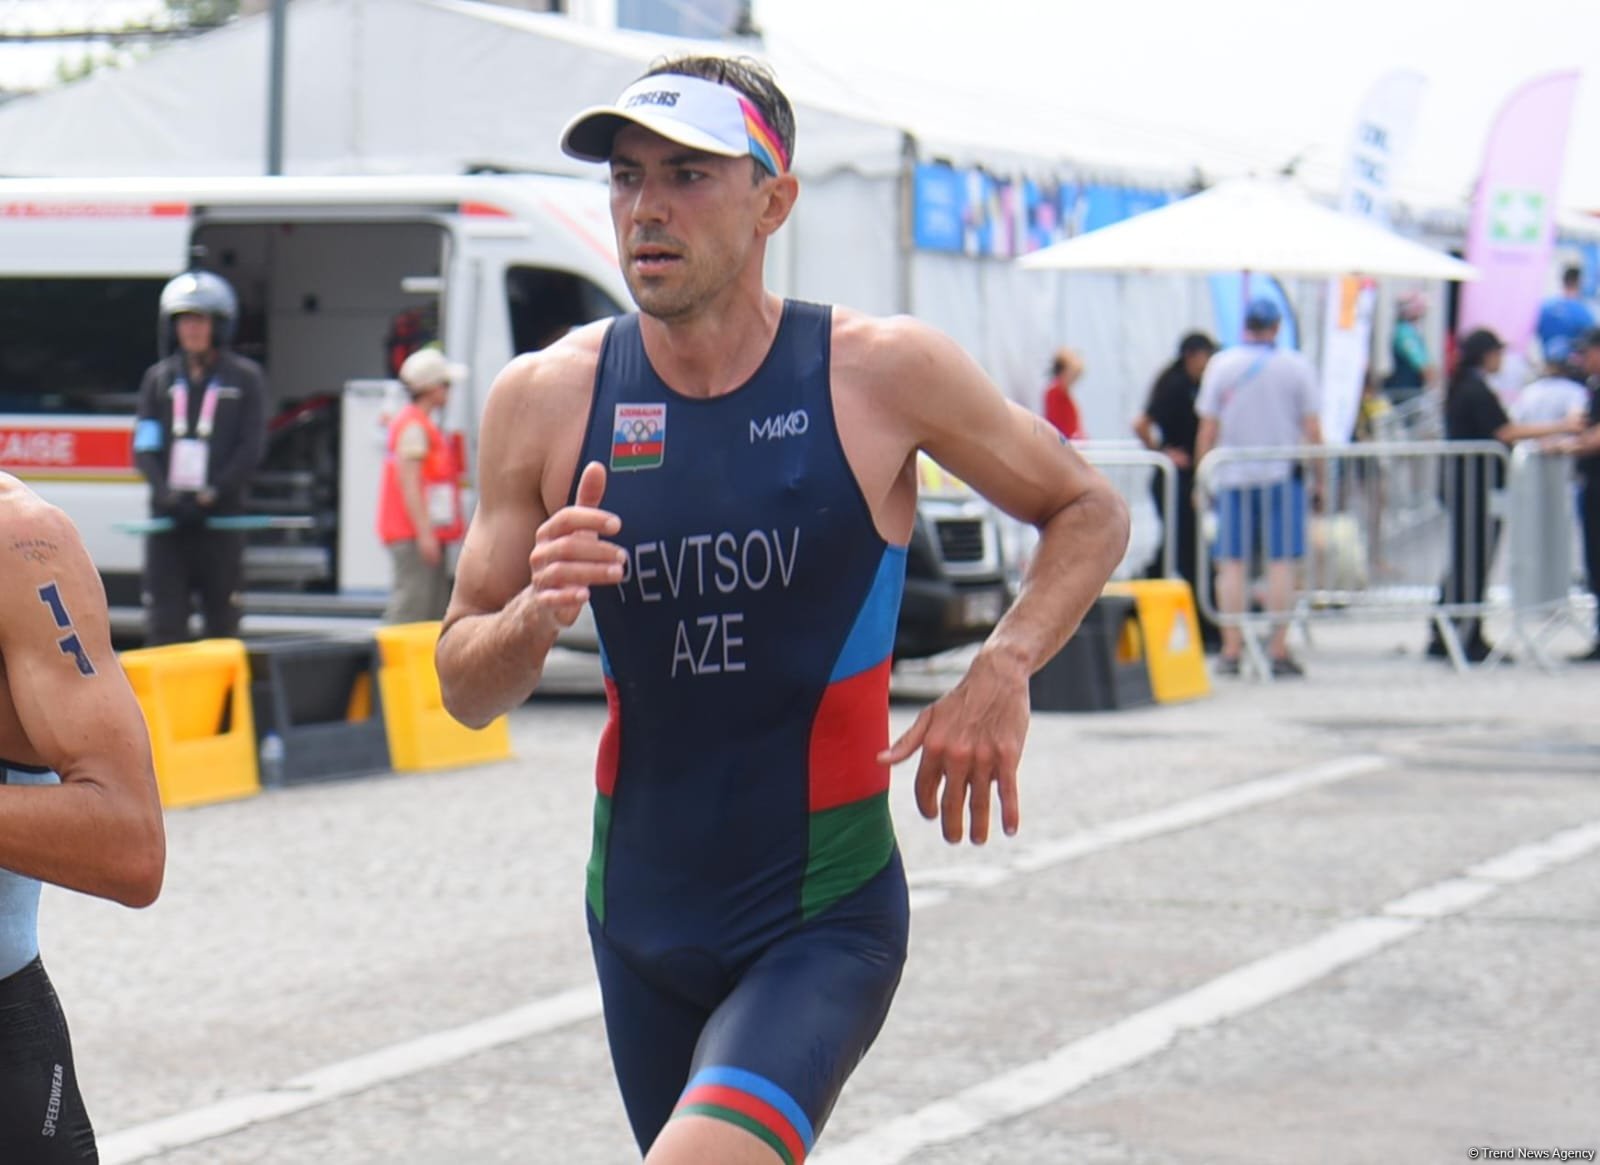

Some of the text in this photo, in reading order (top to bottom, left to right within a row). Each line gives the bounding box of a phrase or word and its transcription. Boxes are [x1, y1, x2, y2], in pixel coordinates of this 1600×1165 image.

[750, 409, 808, 443] MAKO
[671, 613, 746, 678] AZE
[41, 1063, 63, 1137] SPEEDWEAR
